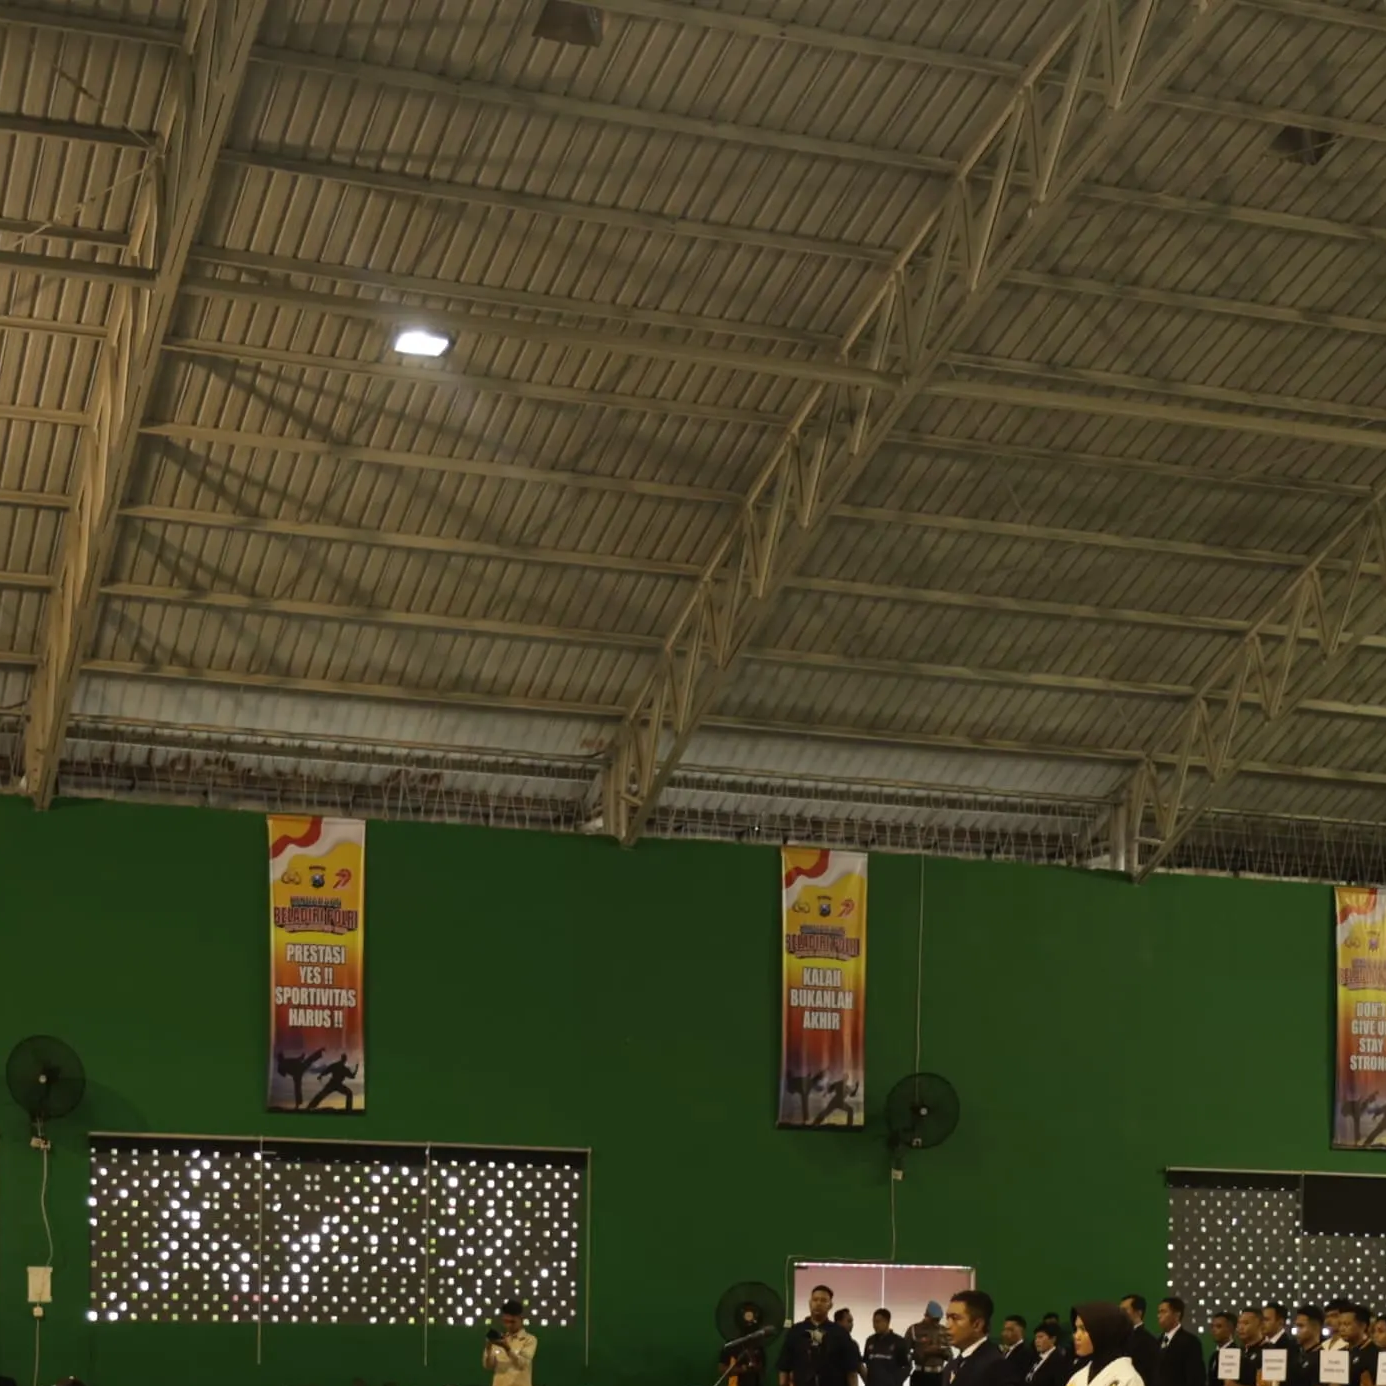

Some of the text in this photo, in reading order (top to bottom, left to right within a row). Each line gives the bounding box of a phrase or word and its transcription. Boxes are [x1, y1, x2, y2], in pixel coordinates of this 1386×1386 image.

[286, 943, 346, 964] PRESTASI
[299, 965, 321, 984] YES
[803, 967, 841, 987] KALAH
[275, 985, 357, 1008] SPORTIVITAS
[789, 988, 853, 1009] BUKANLAH
[288, 1008, 331, 1028] HARUS
[803, 1010, 841, 1030] AKHIR
[1351, 1019, 1376, 1036] GIVE
[1358, 1037, 1384, 1053] STAY
